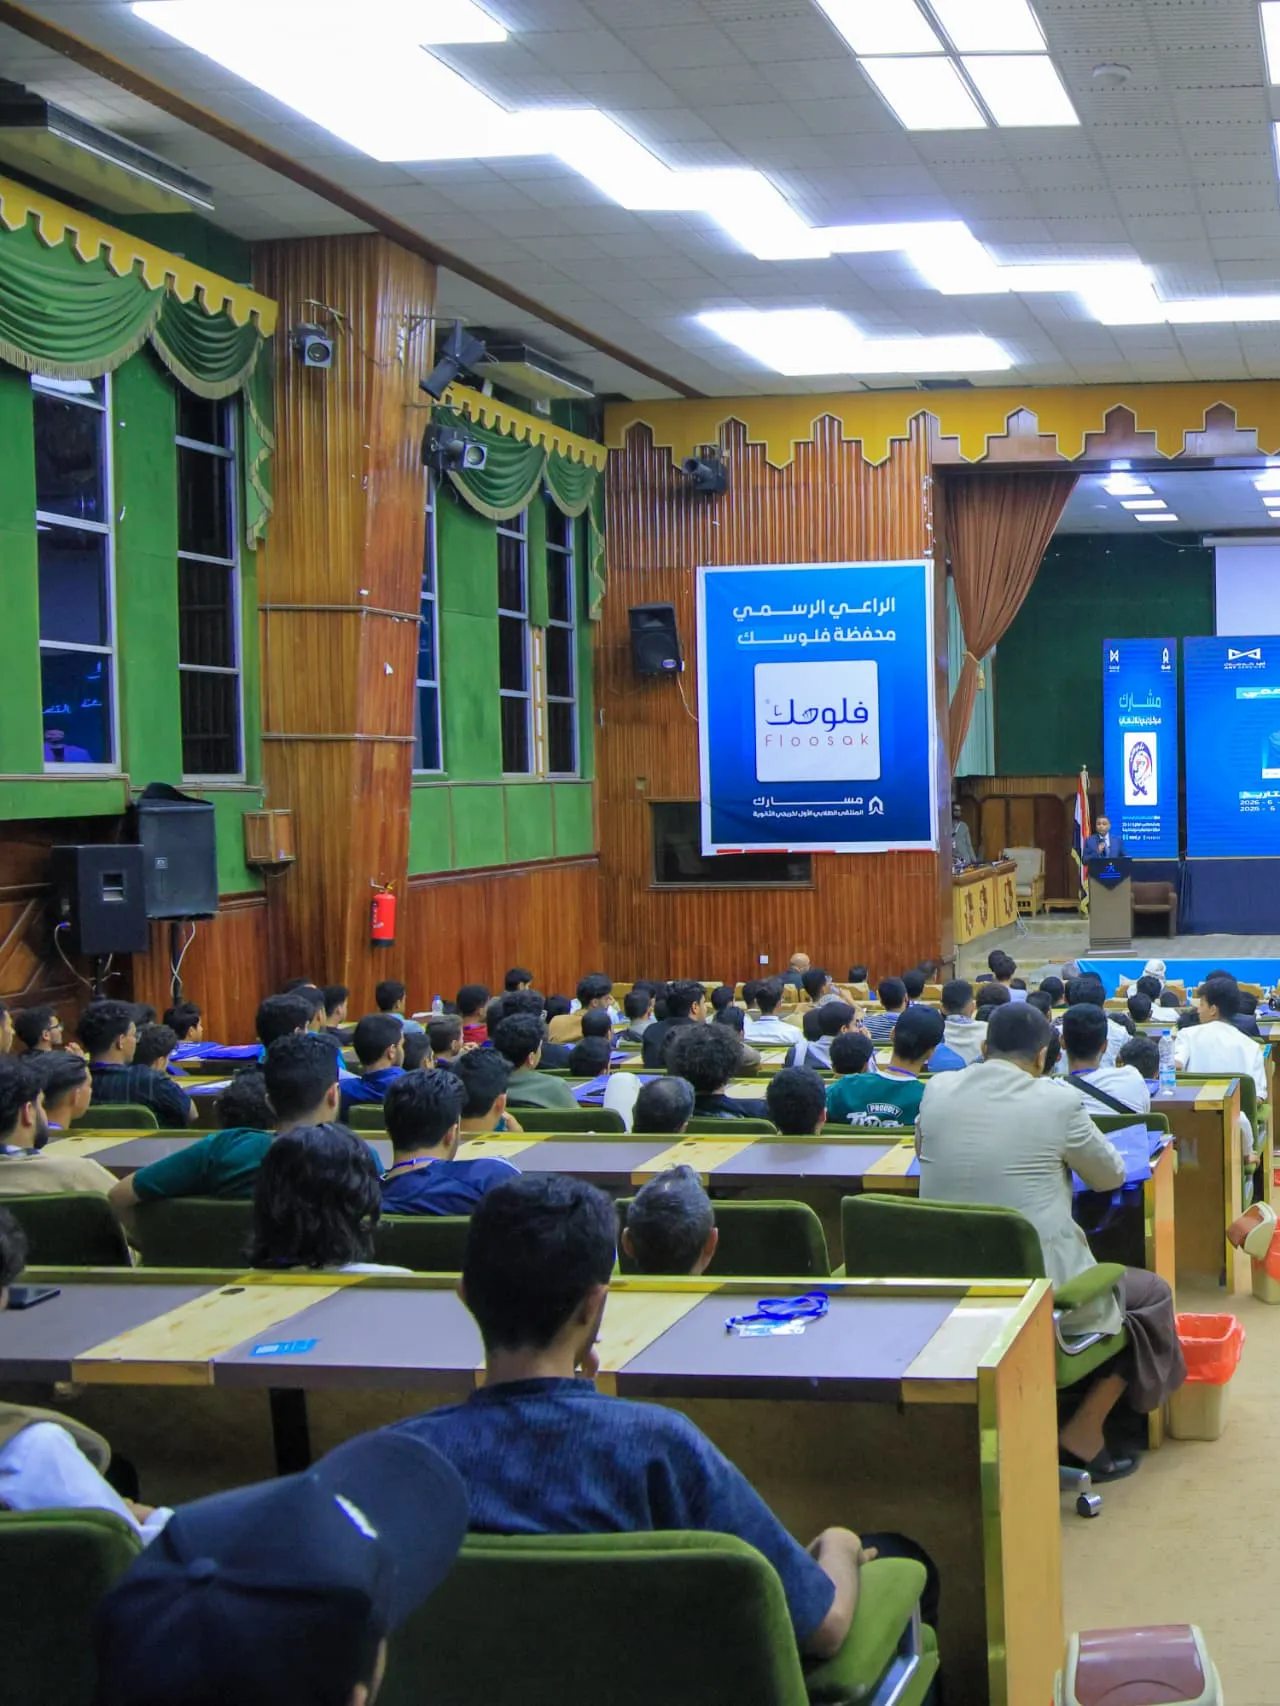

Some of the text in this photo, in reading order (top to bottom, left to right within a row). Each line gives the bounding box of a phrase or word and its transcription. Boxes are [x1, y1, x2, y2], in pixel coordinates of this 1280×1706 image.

[733, 596, 896, 621] الراعي الرسمي
[737, 626, 896, 646] محفظة فلوسك
[765, 733, 869, 748] Floosak
[752, 796, 864, 808] مسارك
